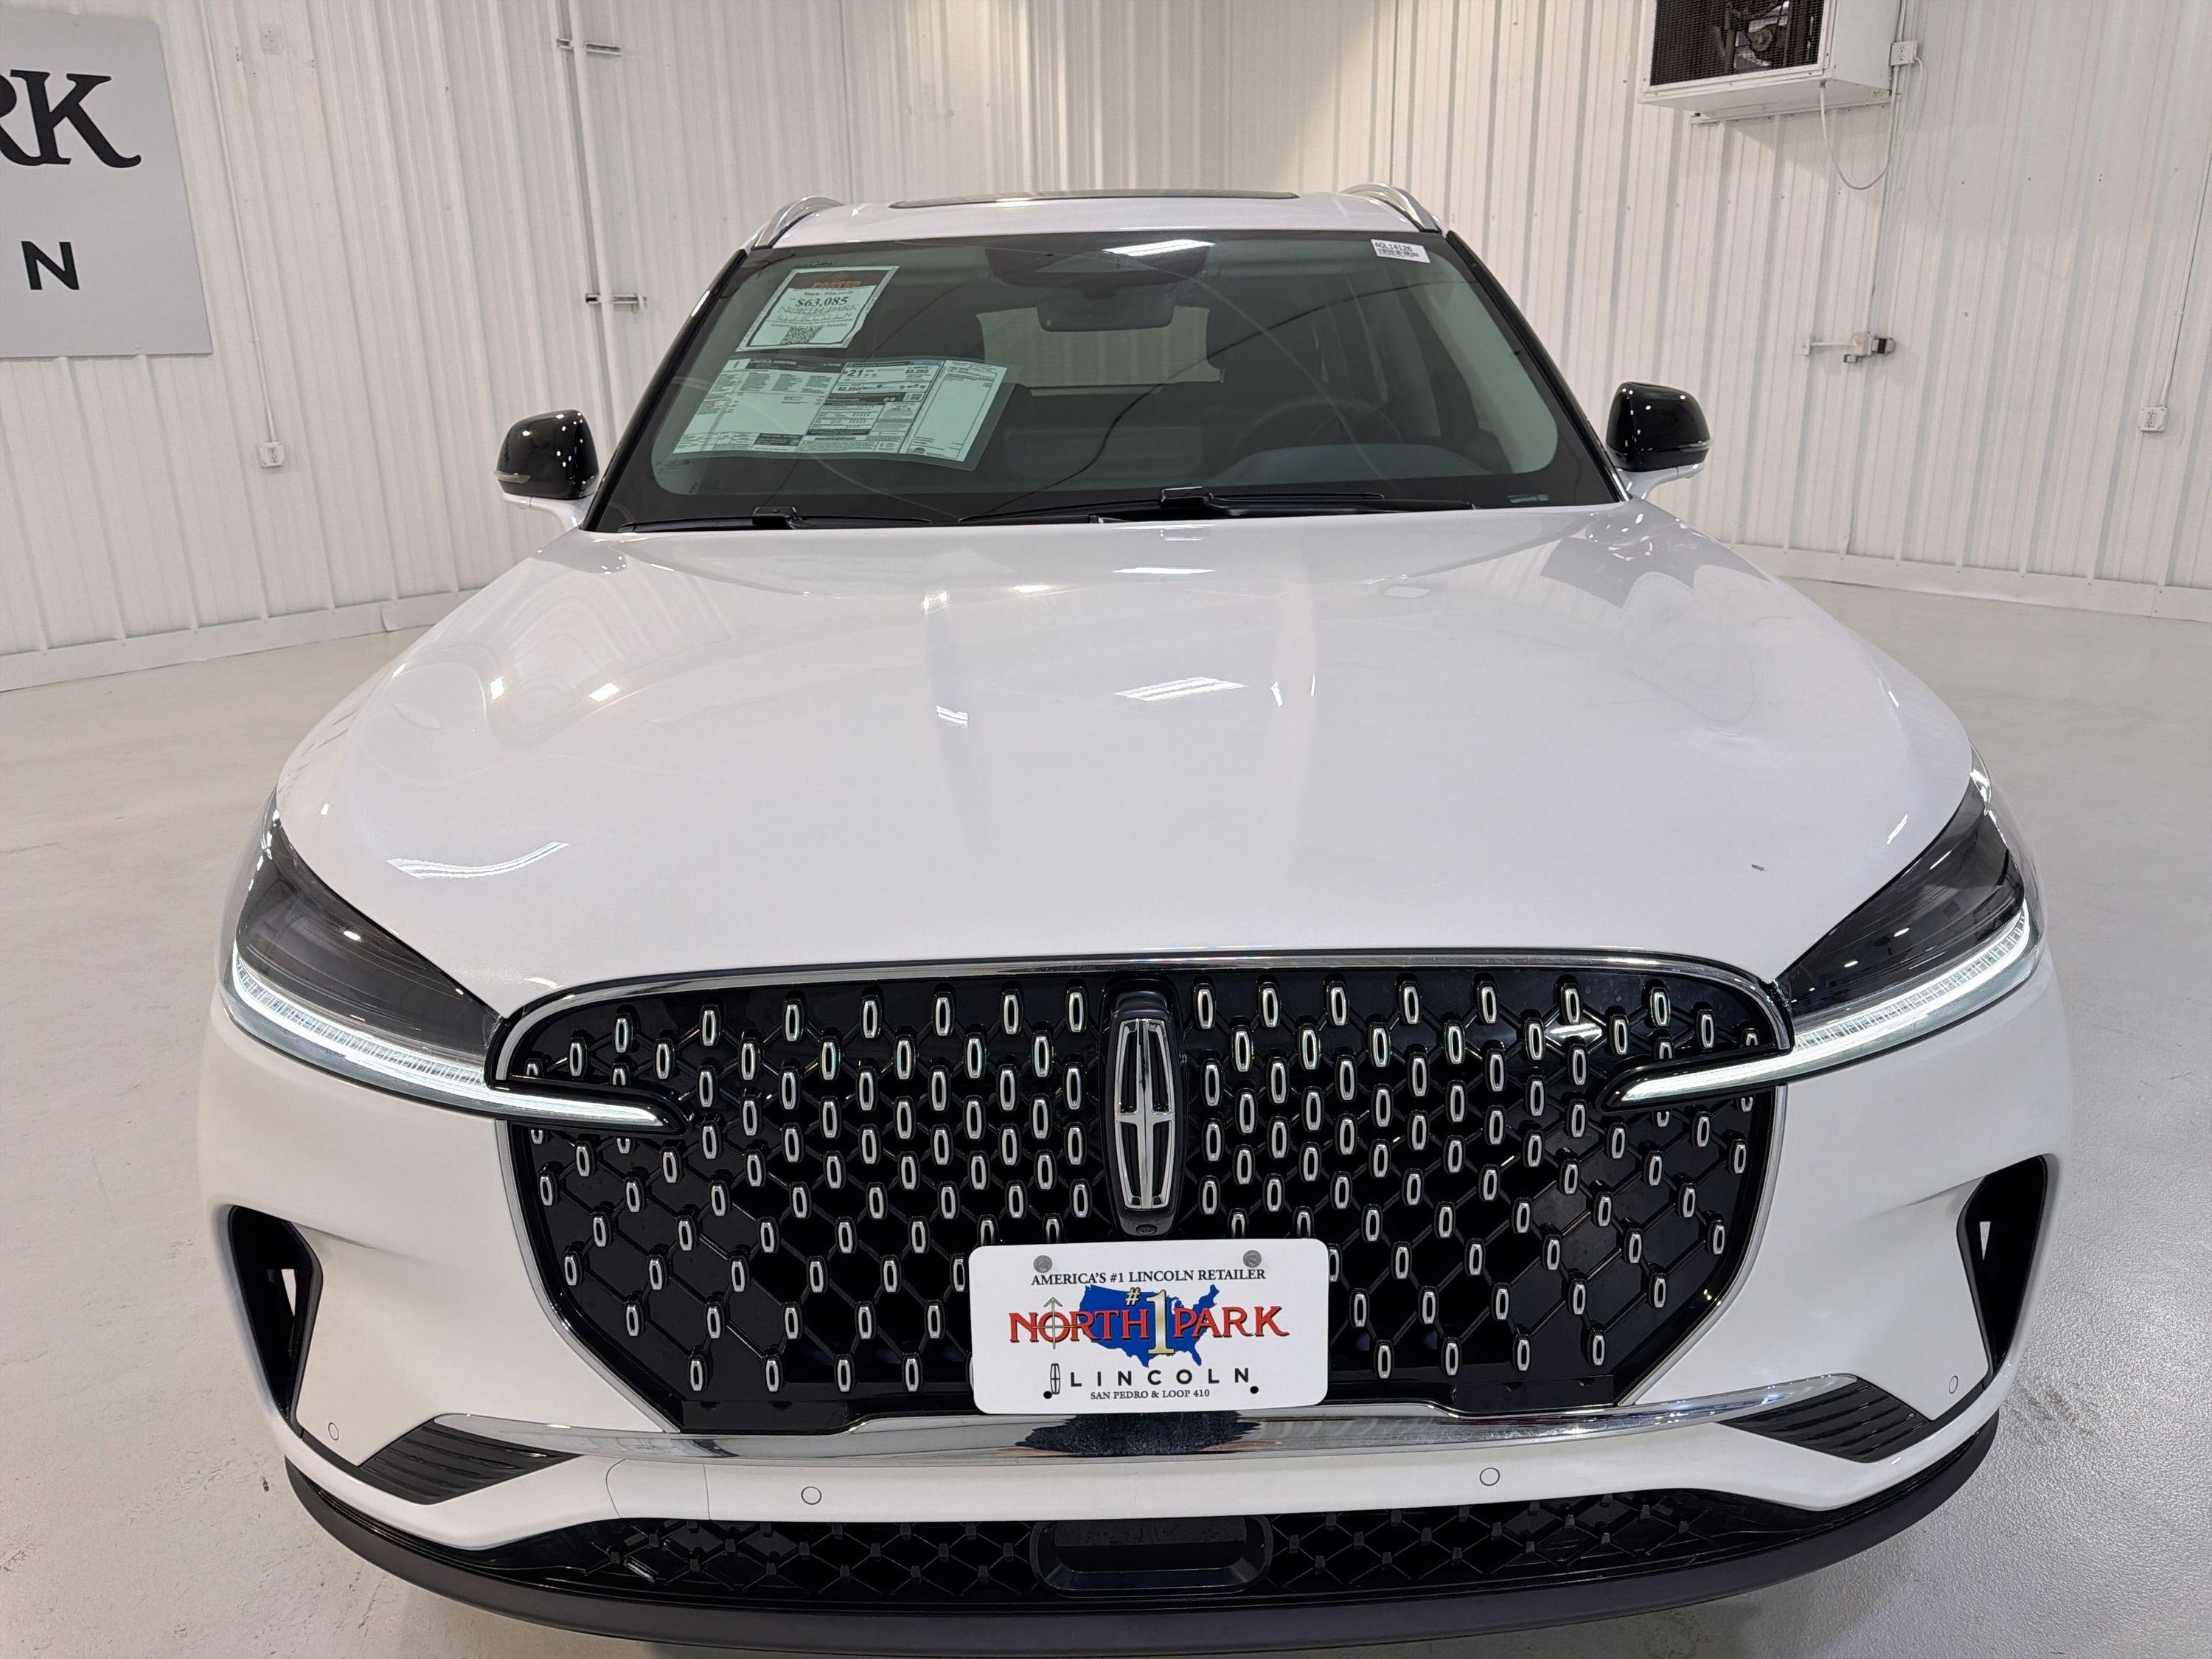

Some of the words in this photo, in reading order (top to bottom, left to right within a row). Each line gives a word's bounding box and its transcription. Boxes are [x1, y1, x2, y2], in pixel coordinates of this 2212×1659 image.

[1031, 1272, 1107, 1286] AMERICA'S
[1110, 1273, 1124, 1284] #1
[1128, 1270, 1194, 1283] LINCOLN
[1197, 1268, 1267, 1281] RETAILER
[1008, 1310, 1150, 1343] NORTH
[1174, 1306, 1290, 1338] PARK
[1070, 1367, 1250, 1388] LINCOLN
[1090, 1391, 1111, 1400] SAN
[1113, 1390, 1148, 1399] PEDRO
[1151, 1390, 1160, 1399] &
[1162, 1390, 1190, 1399] LOOP
[1193, 1388, 1210, 1399] 410
